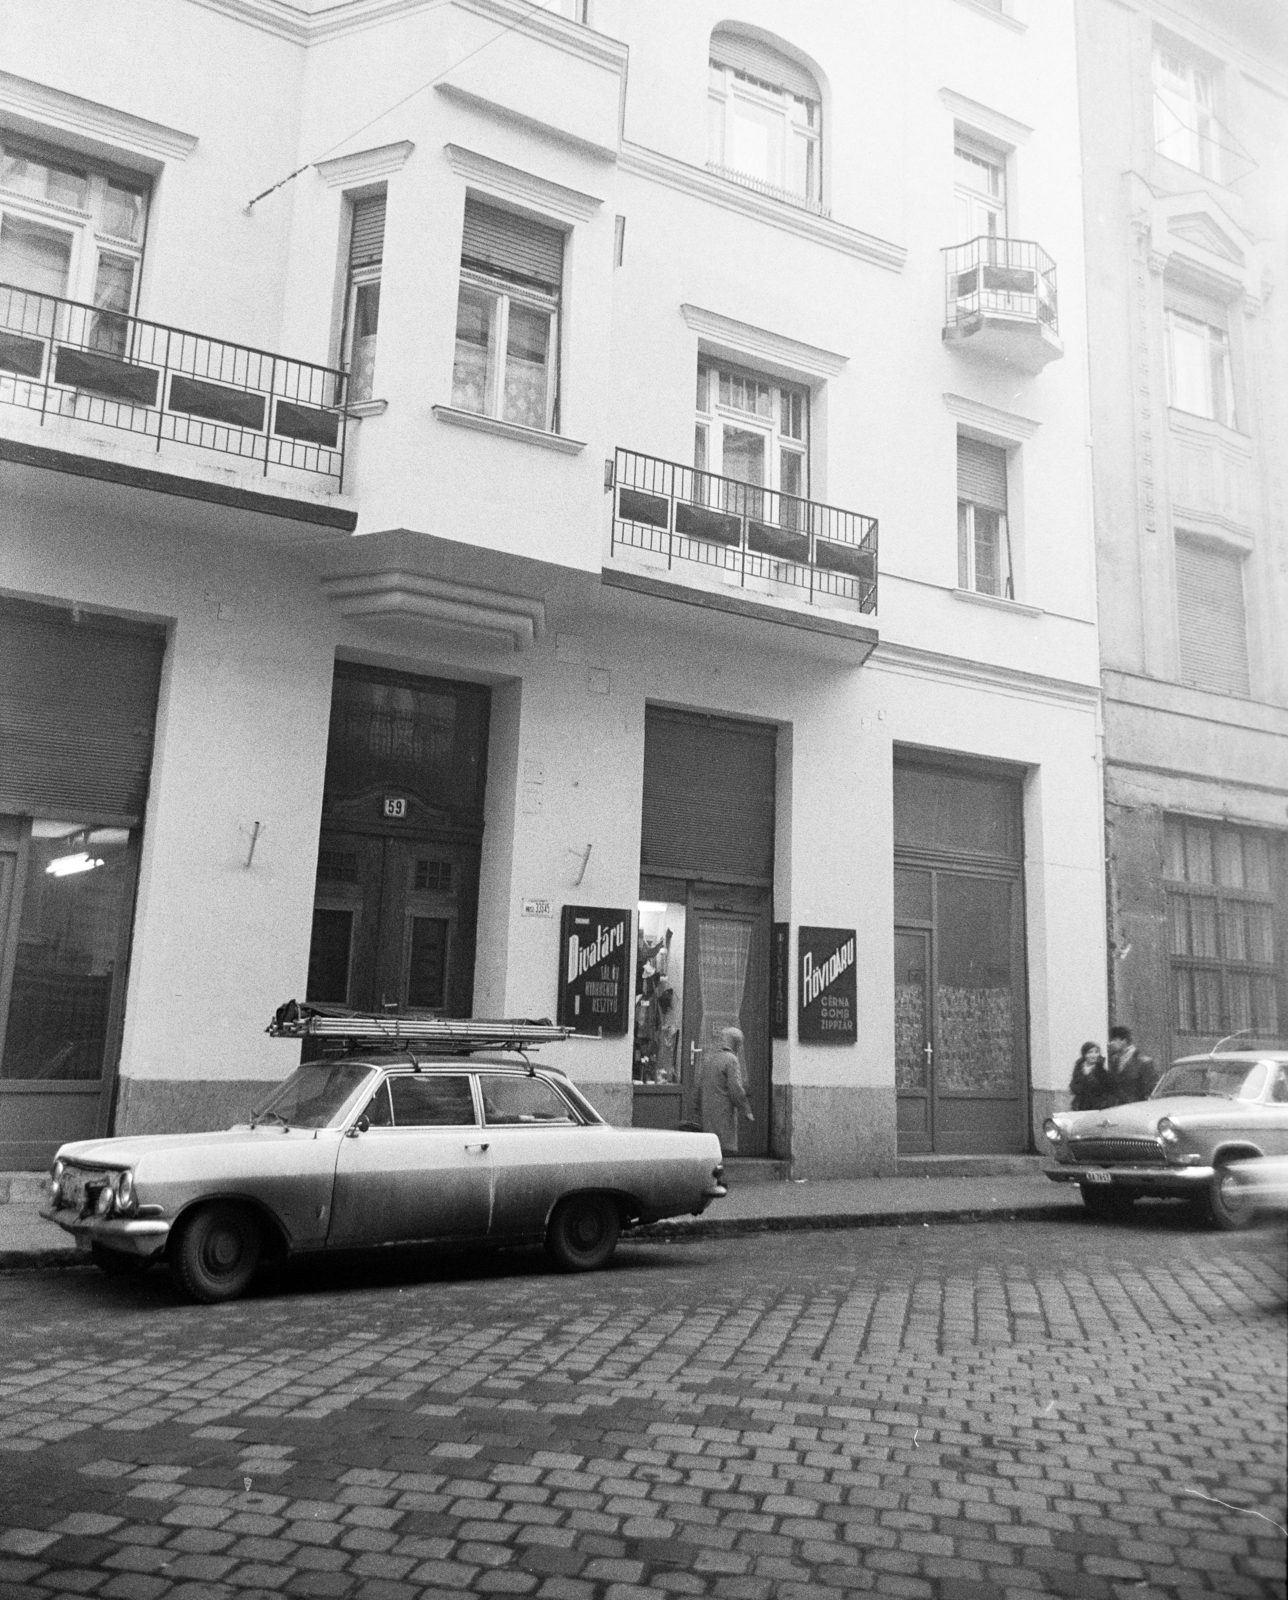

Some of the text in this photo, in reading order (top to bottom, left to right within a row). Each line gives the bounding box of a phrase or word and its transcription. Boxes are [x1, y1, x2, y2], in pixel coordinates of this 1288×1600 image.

[388, 800, 402, 815] 59
[567, 921, 624, 984] Divatáru
[820, 1008, 850, 1019] GOMB
